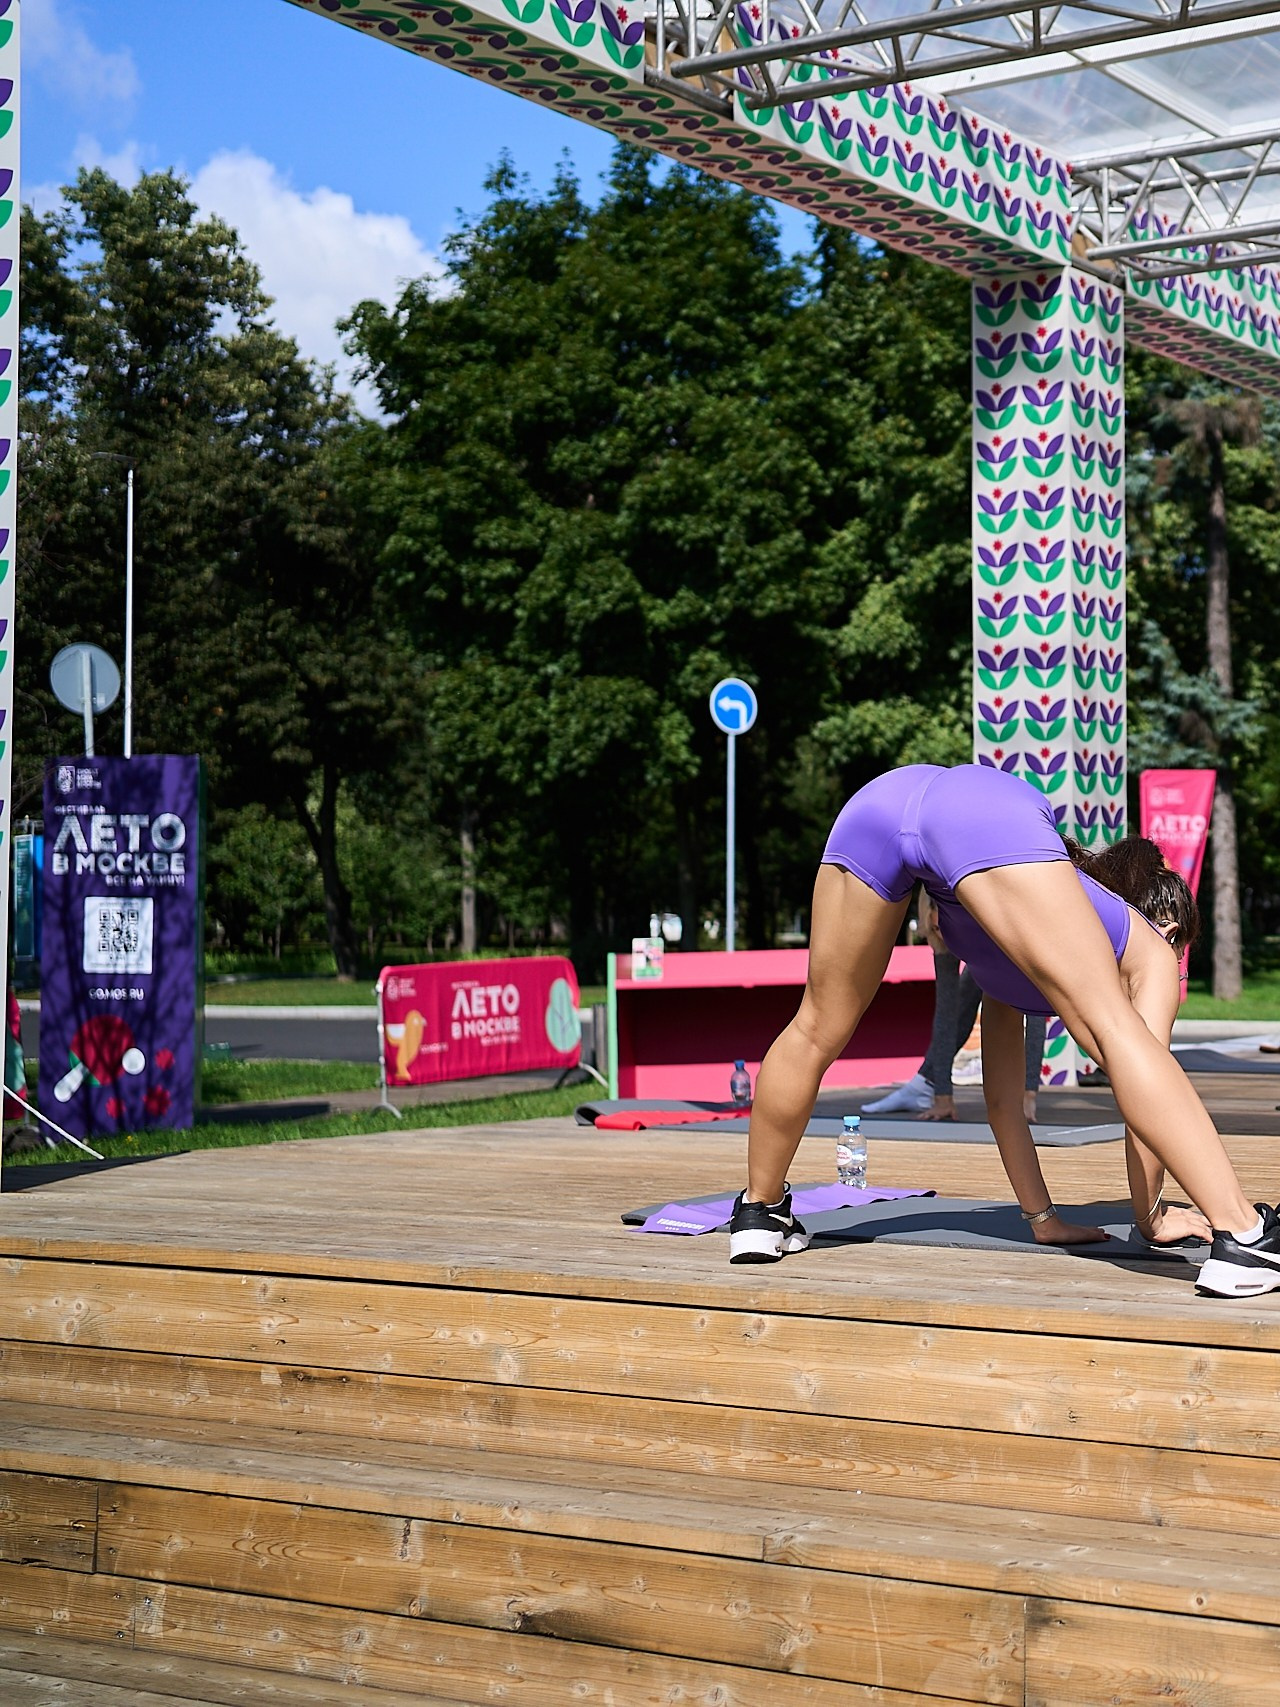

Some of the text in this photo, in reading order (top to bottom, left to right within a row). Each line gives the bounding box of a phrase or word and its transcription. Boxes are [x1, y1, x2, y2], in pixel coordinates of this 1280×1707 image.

[53, 812, 186, 852] ЛЕТО
[1149, 814, 1207, 832] ЛЕТО
[52, 852, 186, 875] В МОСКВЕ
[451, 983, 520, 1019] ЛЕТО
[451, 1015, 520, 1040] В МОСКВЕ
